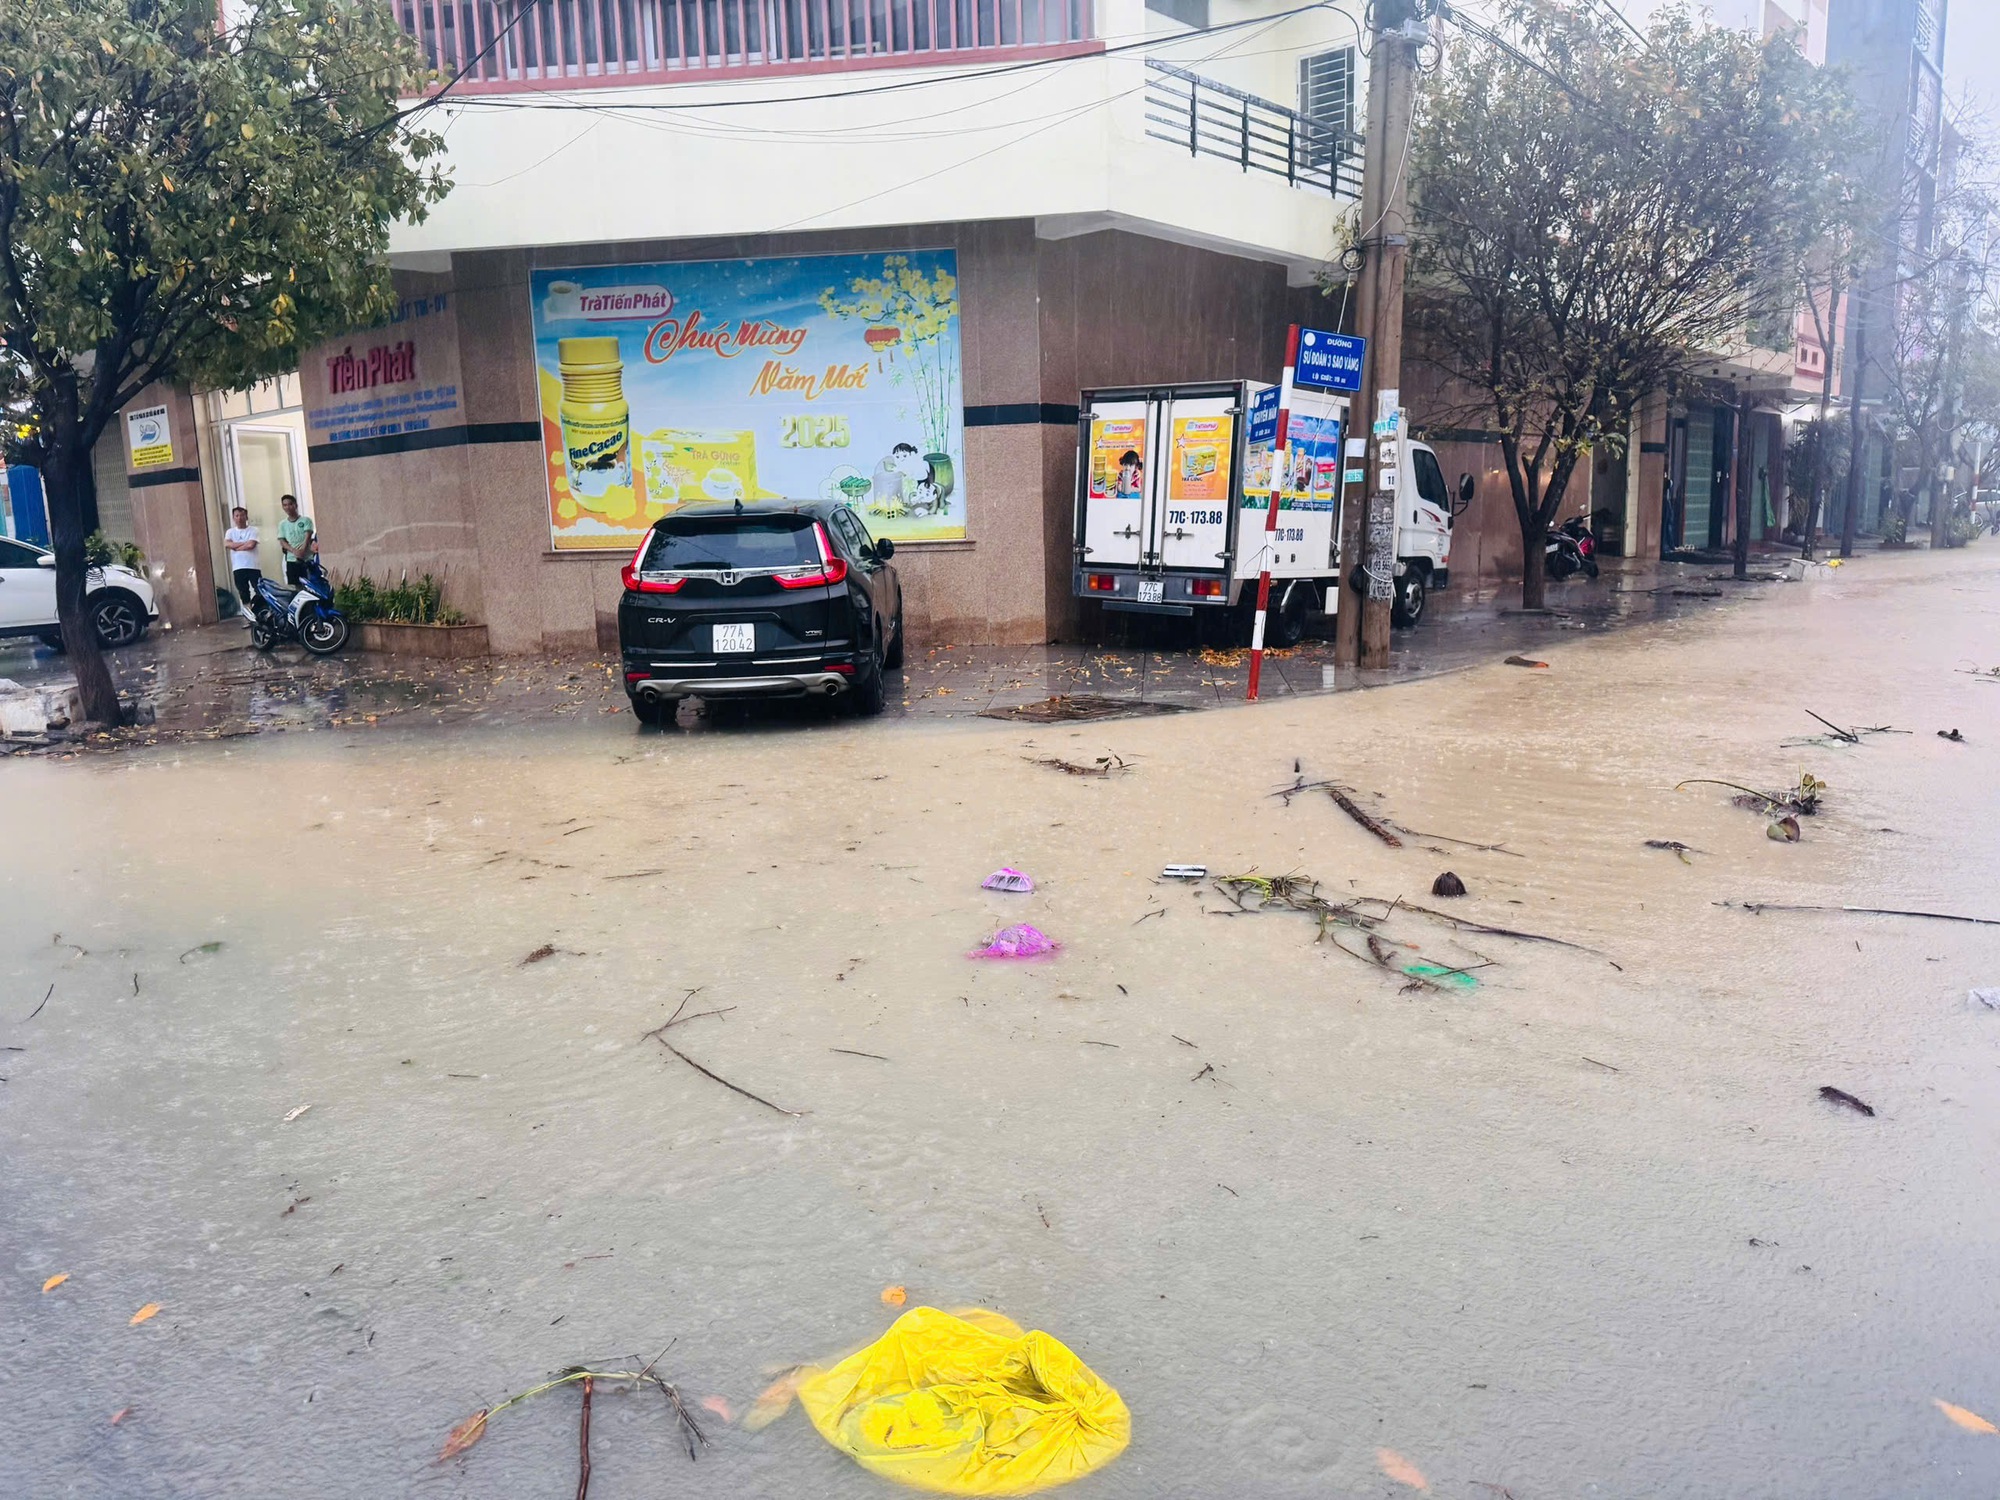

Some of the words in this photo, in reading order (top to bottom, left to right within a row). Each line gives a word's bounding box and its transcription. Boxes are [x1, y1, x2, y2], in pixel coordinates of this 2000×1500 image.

[644, 310, 736, 364] Chúc
[731, 320, 808, 356] Mừng
[1332, 354, 1344, 369] SAO
[749, 360, 822, 400] Năm
[818, 362, 869, 391] Mới
[779, 415, 850, 449] 2025
[1144, 582, 1158, 592] 77C
[722, 625, 744, 638] 77A
[715, 638, 753, 651] 120.42
